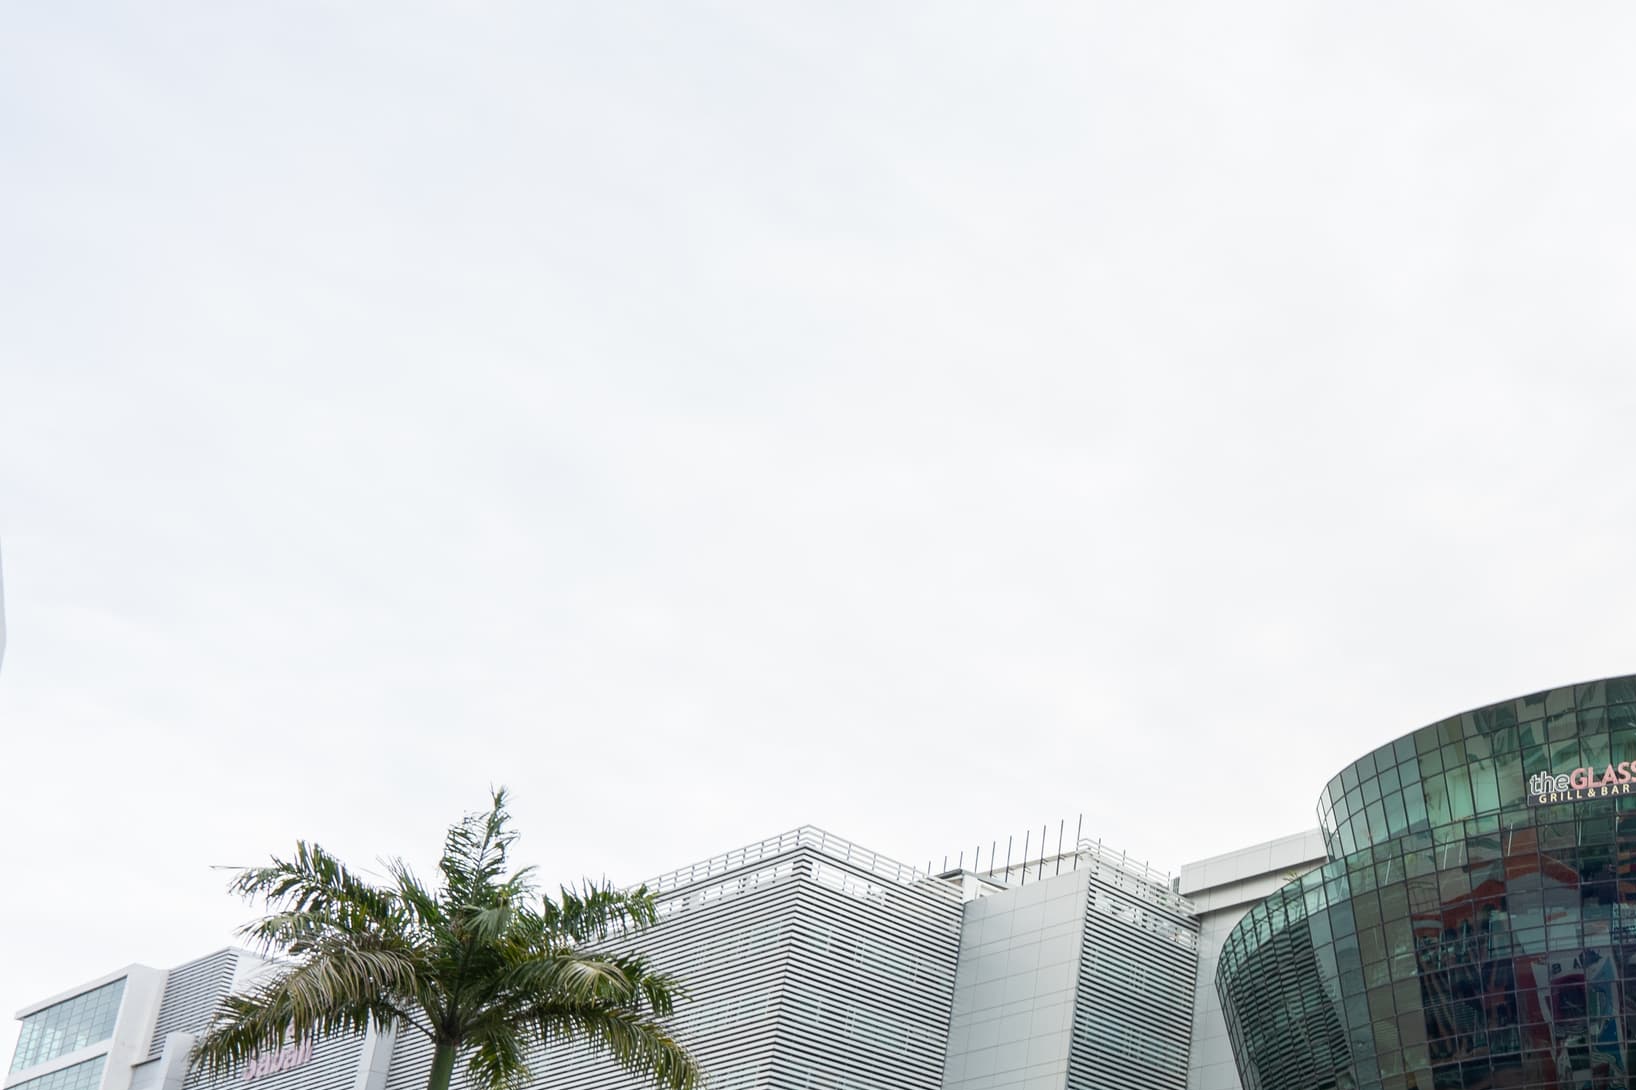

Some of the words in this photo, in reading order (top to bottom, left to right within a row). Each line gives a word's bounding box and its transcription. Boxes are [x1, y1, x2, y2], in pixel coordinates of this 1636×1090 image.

[1539, 790, 1582, 803] GRILL
[1587, 788, 1596, 798] &
[1601, 783, 1630, 796] BAR
